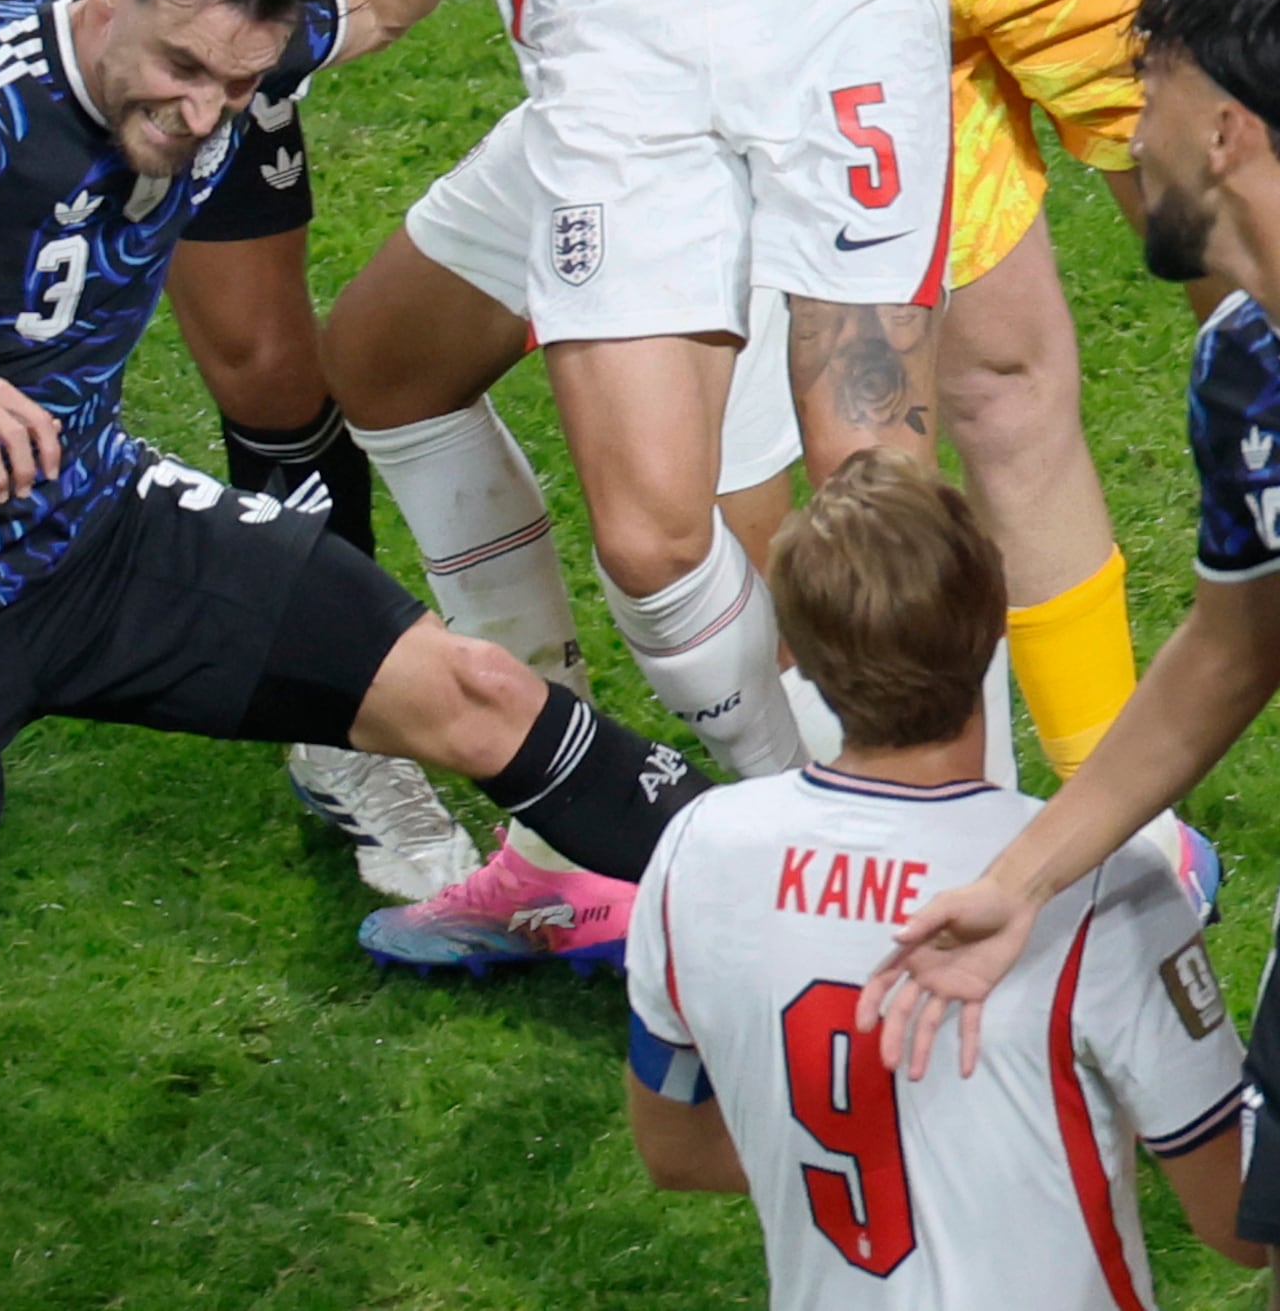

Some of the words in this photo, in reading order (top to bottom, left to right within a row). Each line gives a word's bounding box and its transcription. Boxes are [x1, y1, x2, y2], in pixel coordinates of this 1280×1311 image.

[830, 82, 903, 209] 5
[14, 234, 89, 341] 3
[136, 459, 225, 511] 3
[776, 847, 929, 925] KANE
[781, 979, 917, 1279] 9
